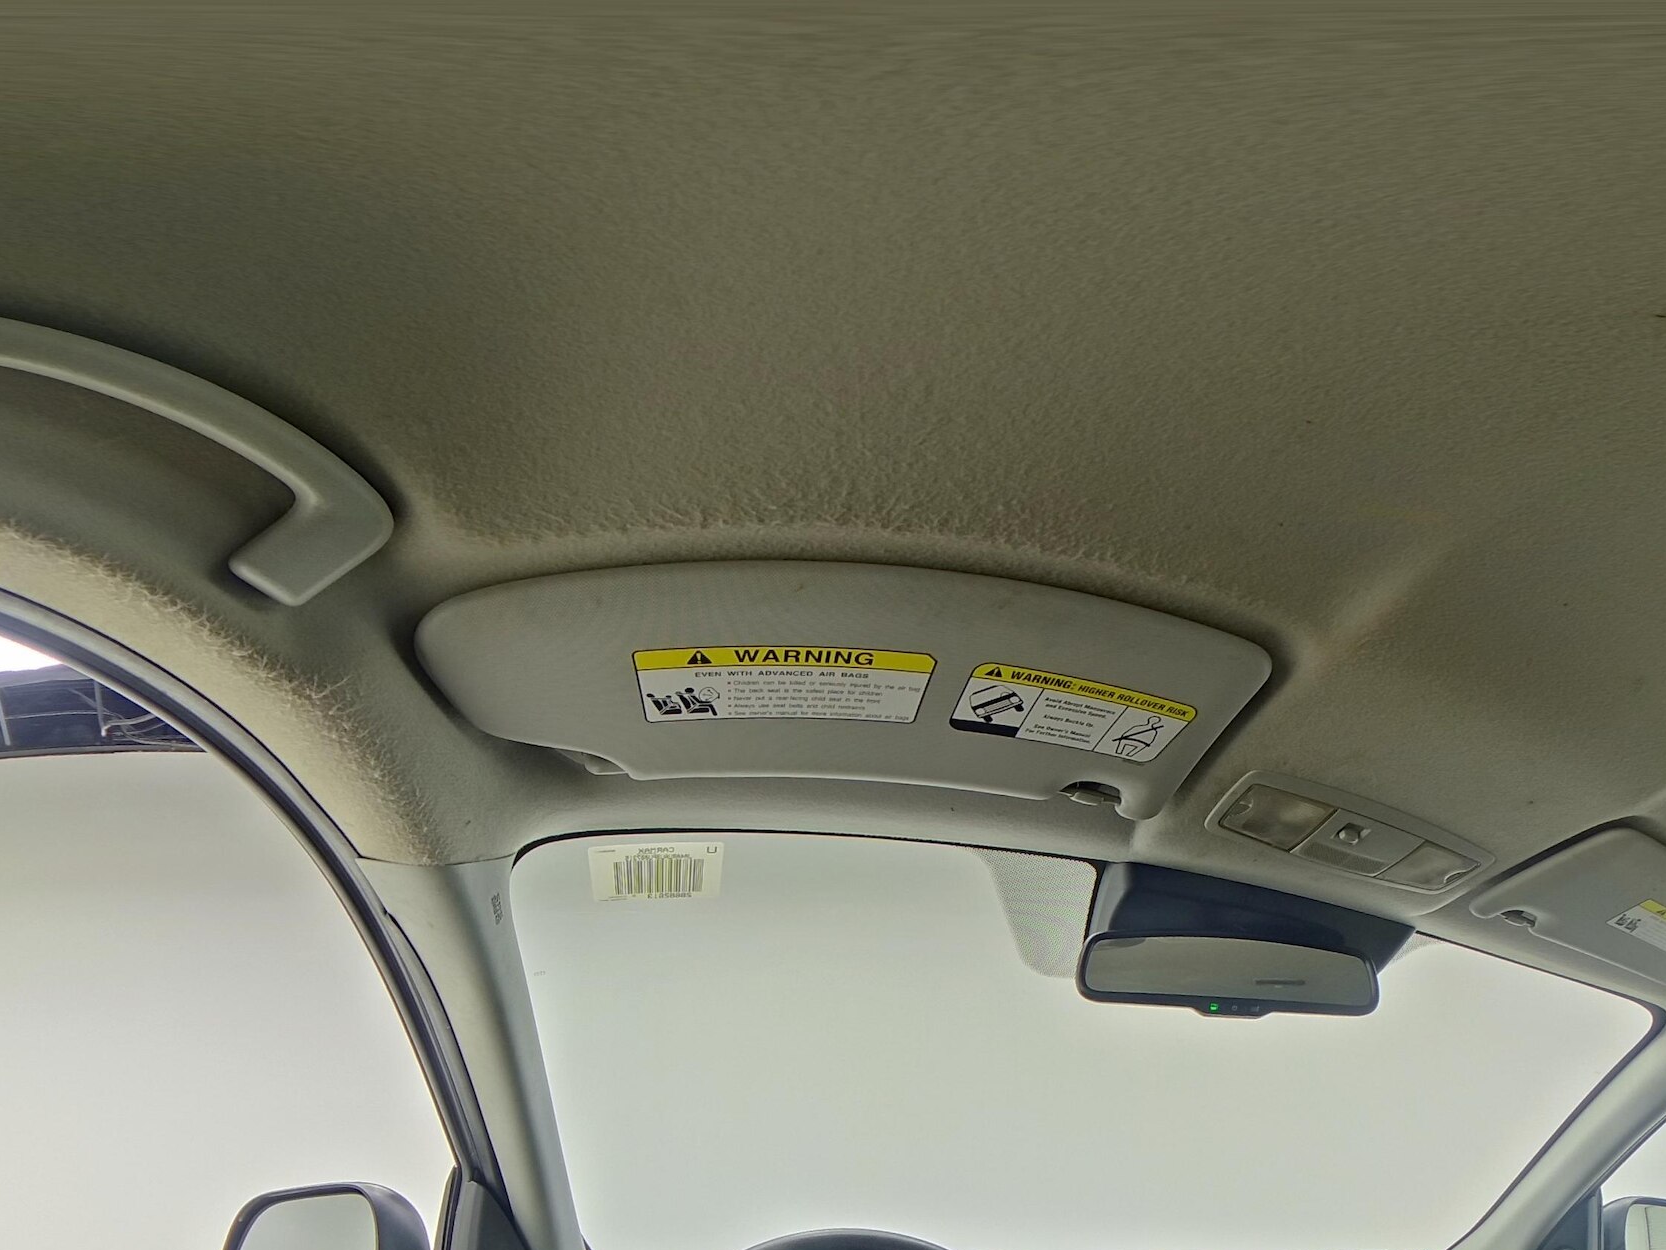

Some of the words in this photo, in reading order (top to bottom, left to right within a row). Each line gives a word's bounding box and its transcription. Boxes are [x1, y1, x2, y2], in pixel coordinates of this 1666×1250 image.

[734, 650, 874, 665] WARNING
[1010, 670, 1076, 690] WARNING:
[1078, 685, 1116, 698] HIGHER
[1117, 691, 1165, 711] ROLLOVER
[1166, 704, 1189, 717] RISK
[1058, 706, 1086, 714] Excessive
[1063, 700, 1083, 708] Abrupt
[1084, 704, 1115, 715] Maneuvers
[1046, 726, 1068, 734] Owner's
